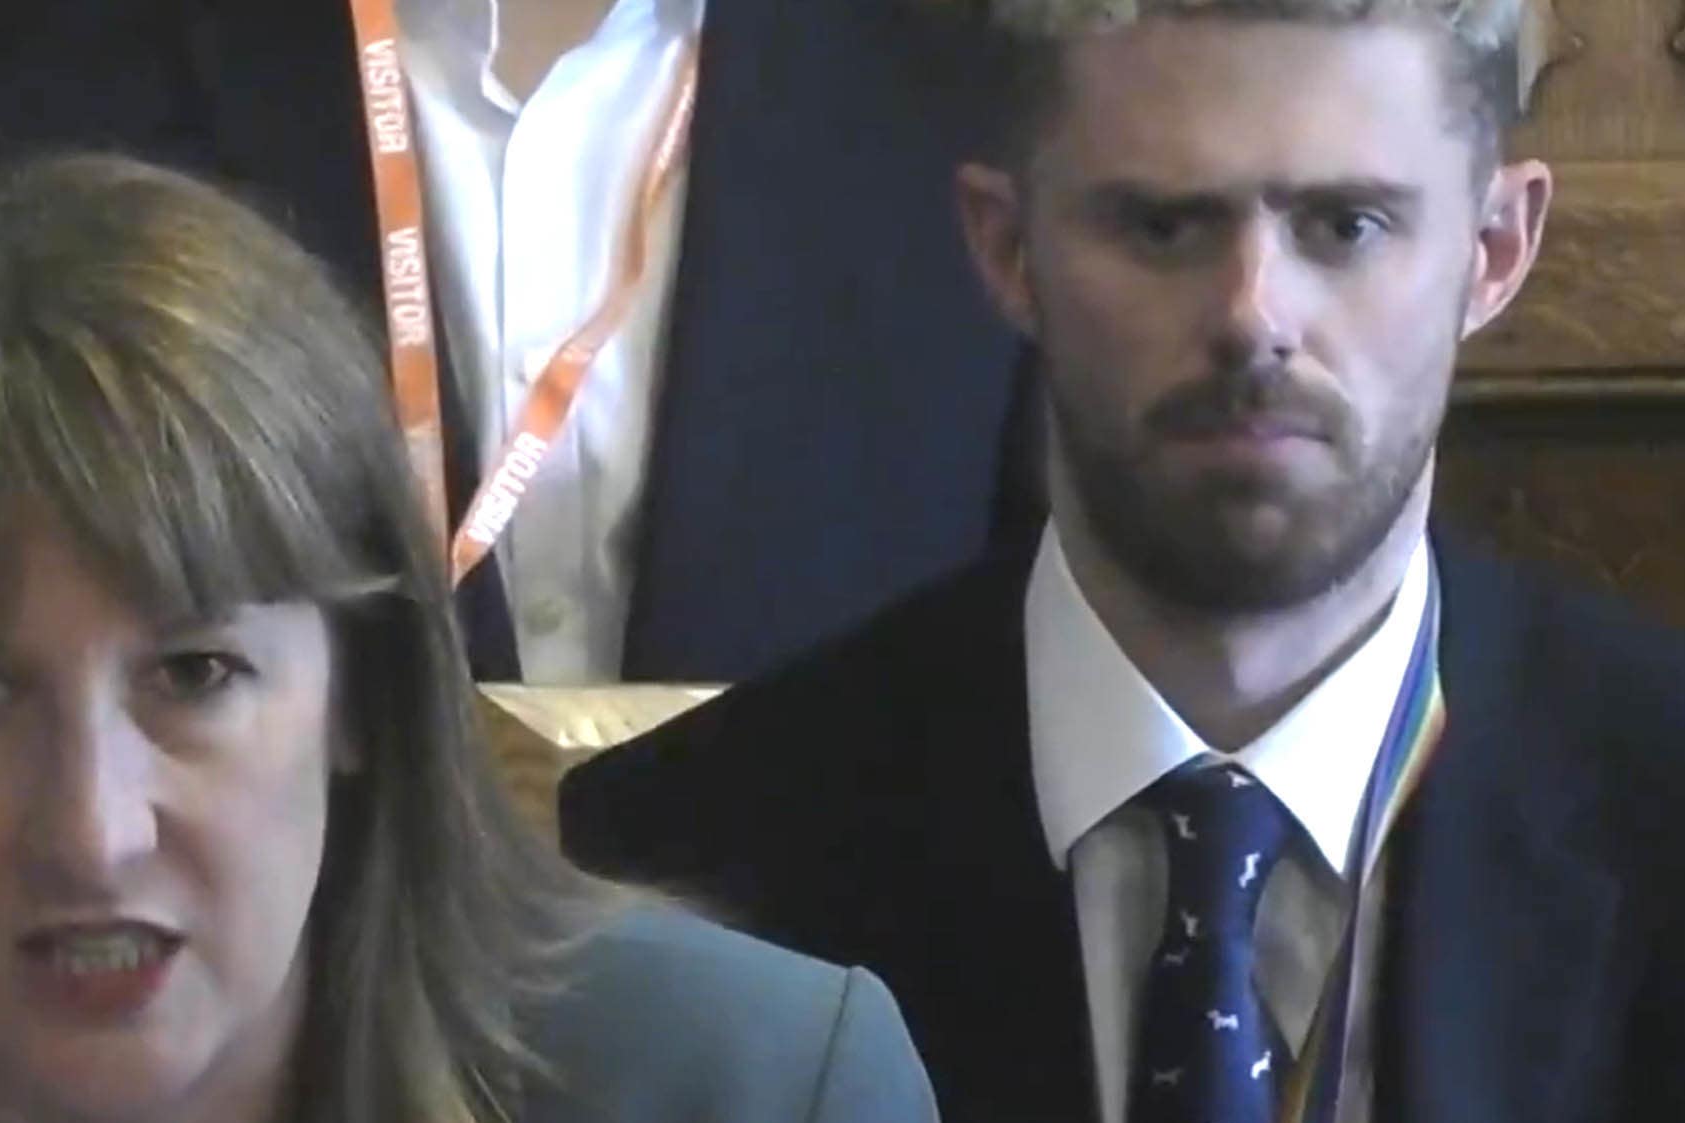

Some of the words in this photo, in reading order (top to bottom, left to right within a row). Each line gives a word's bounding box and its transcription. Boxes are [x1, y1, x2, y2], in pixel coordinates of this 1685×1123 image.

[364, 38, 409, 153] VISITOR
[386, 226, 429, 347] VISITOR
[467, 431, 549, 544] VISITOR
